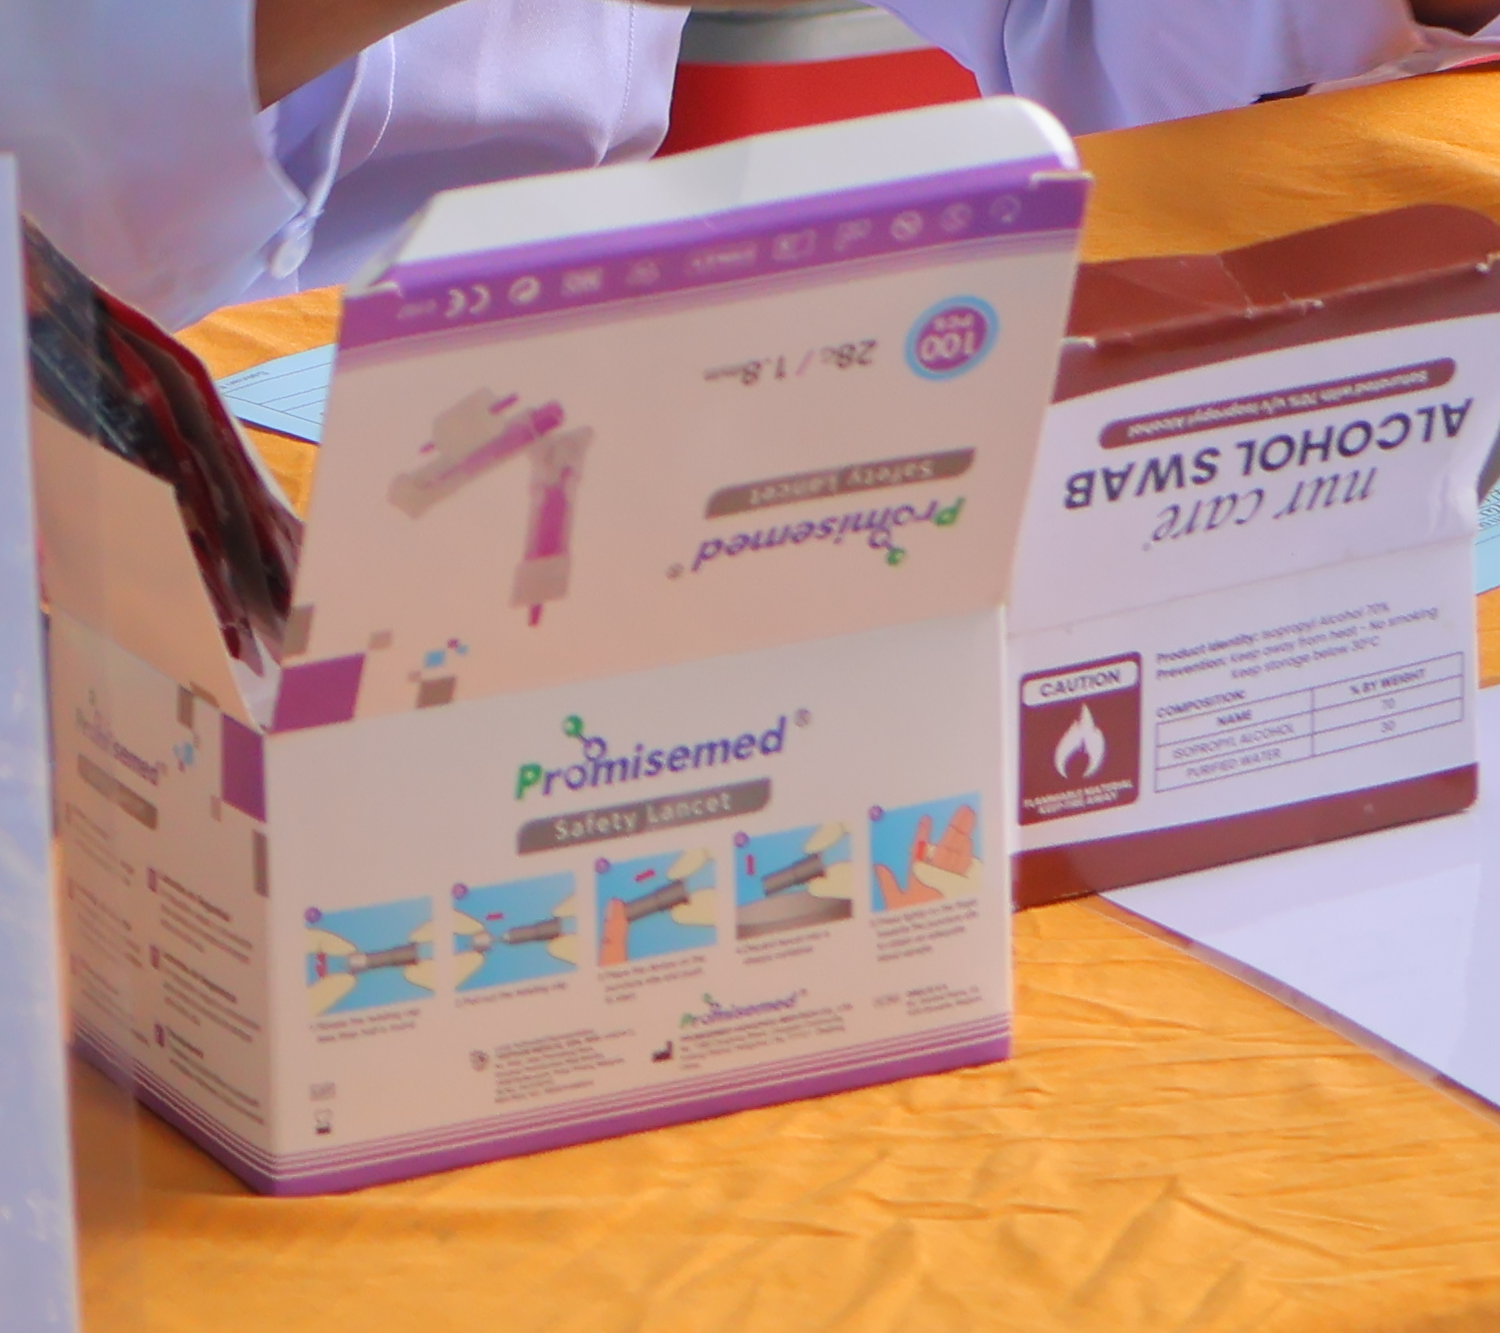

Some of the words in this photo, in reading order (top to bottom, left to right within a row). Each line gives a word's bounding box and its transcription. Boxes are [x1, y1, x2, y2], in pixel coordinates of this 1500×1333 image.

[920, 330, 975, 362] 100
[1236, 397, 1473, 477] ALCOHOL
[750, 473, 839, 505] Lancet
[848, 460, 934, 486] Safety
[1063, 446, 1221, 510] SWAB
[1273, 466, 1378, 520] nur
[692, 496, 966, 573] Promisemed
[1151, 487, 1266, 542] care
[1156, 646, 1206, 664] Product
[1230, 649, 1260, 665] Keep
[1298, 633, 1328, 648] from
[1388, 607, 1439, 627] smoking
[1264, 653, 1311, 674] storage
[1313, 644, 1349, 661] below
[1040, 669, 1121, 698] CAUTION
[1217, 709, 1253, 727] NAME
[1362, 680, 1378, 694] BY
[1380, 668, 1427, 688] WEIGHT
[1240, 723, 1295, 745] ALCOHOL
[1382, 698, 1397, 710] 70
[515, 714, 788, 801] Promisemed
[1240, 747, 1281, 766] WATER
[553, 811, 638, 841] Safety
[646, 792, 732, 824] Lancet
